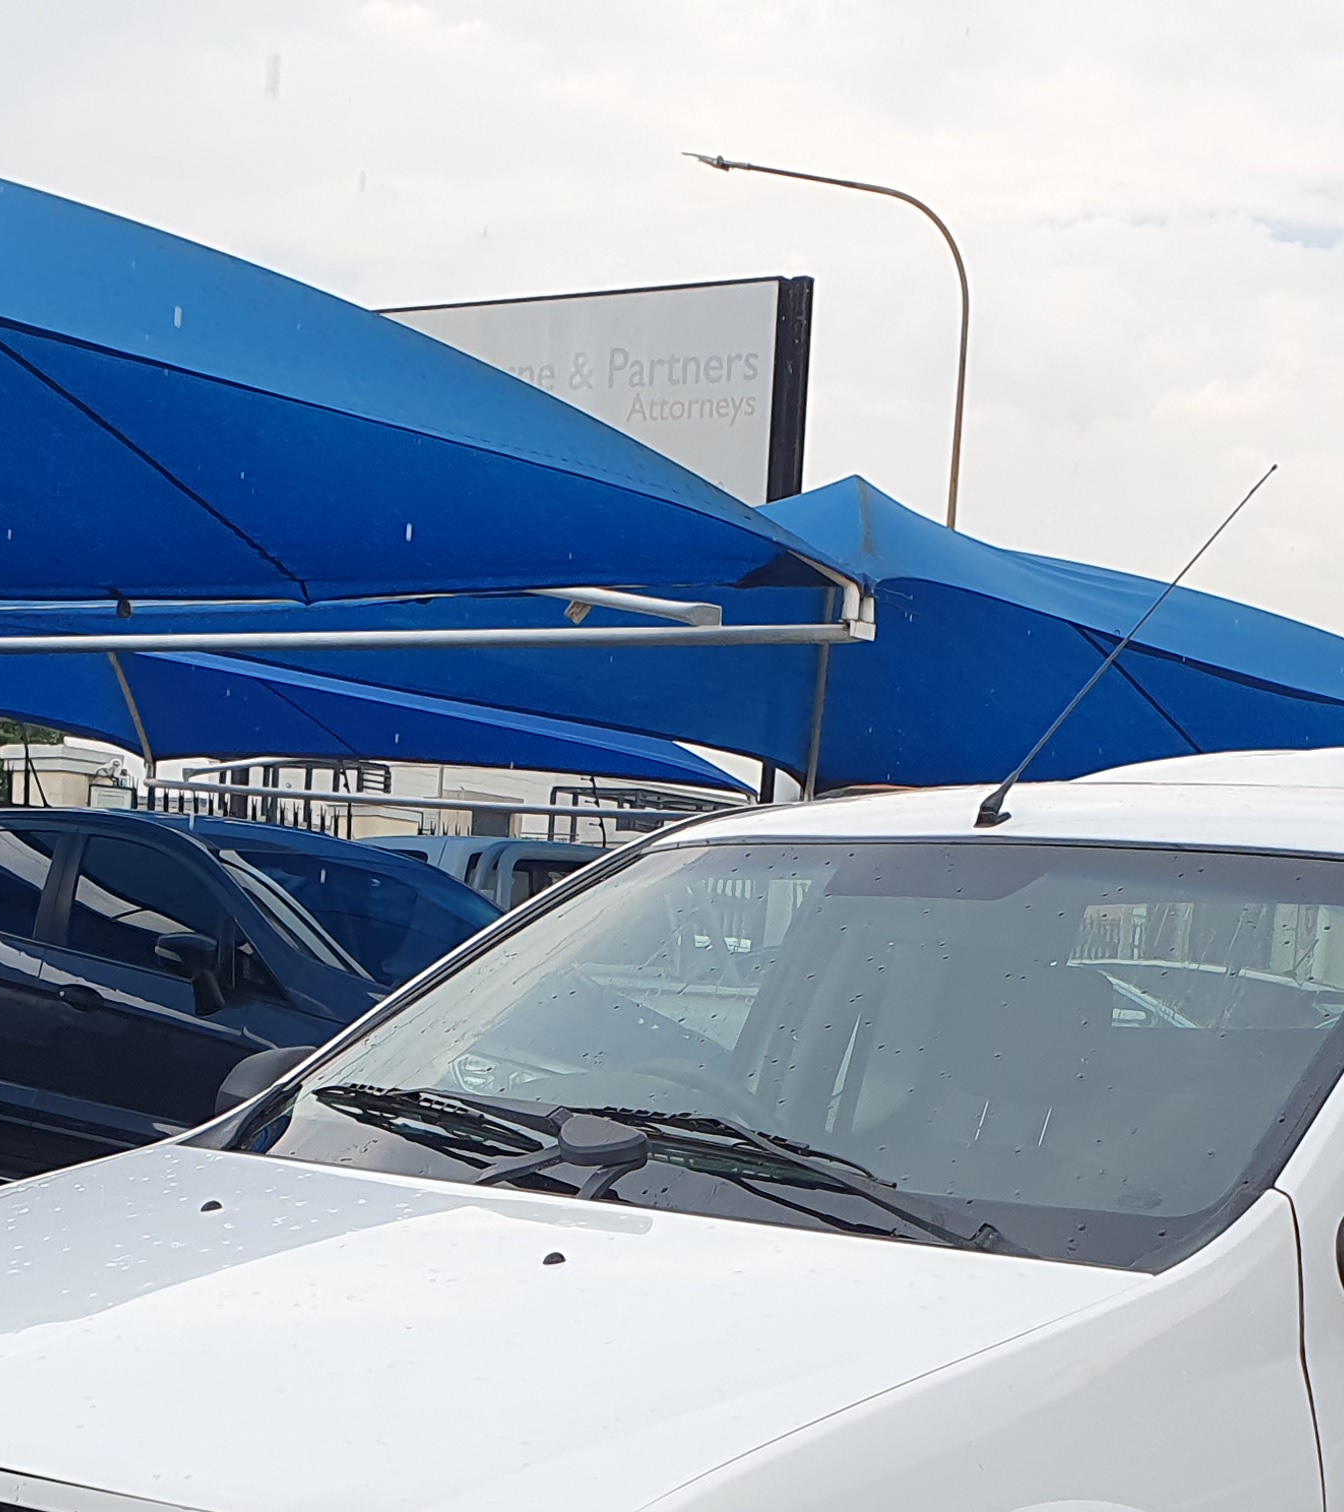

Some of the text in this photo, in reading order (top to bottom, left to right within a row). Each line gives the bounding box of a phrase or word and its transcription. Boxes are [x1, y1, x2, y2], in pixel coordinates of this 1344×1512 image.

[508, 347, 760, 391] ne & Partners
[626, 392, 757, 428] Attorneys
